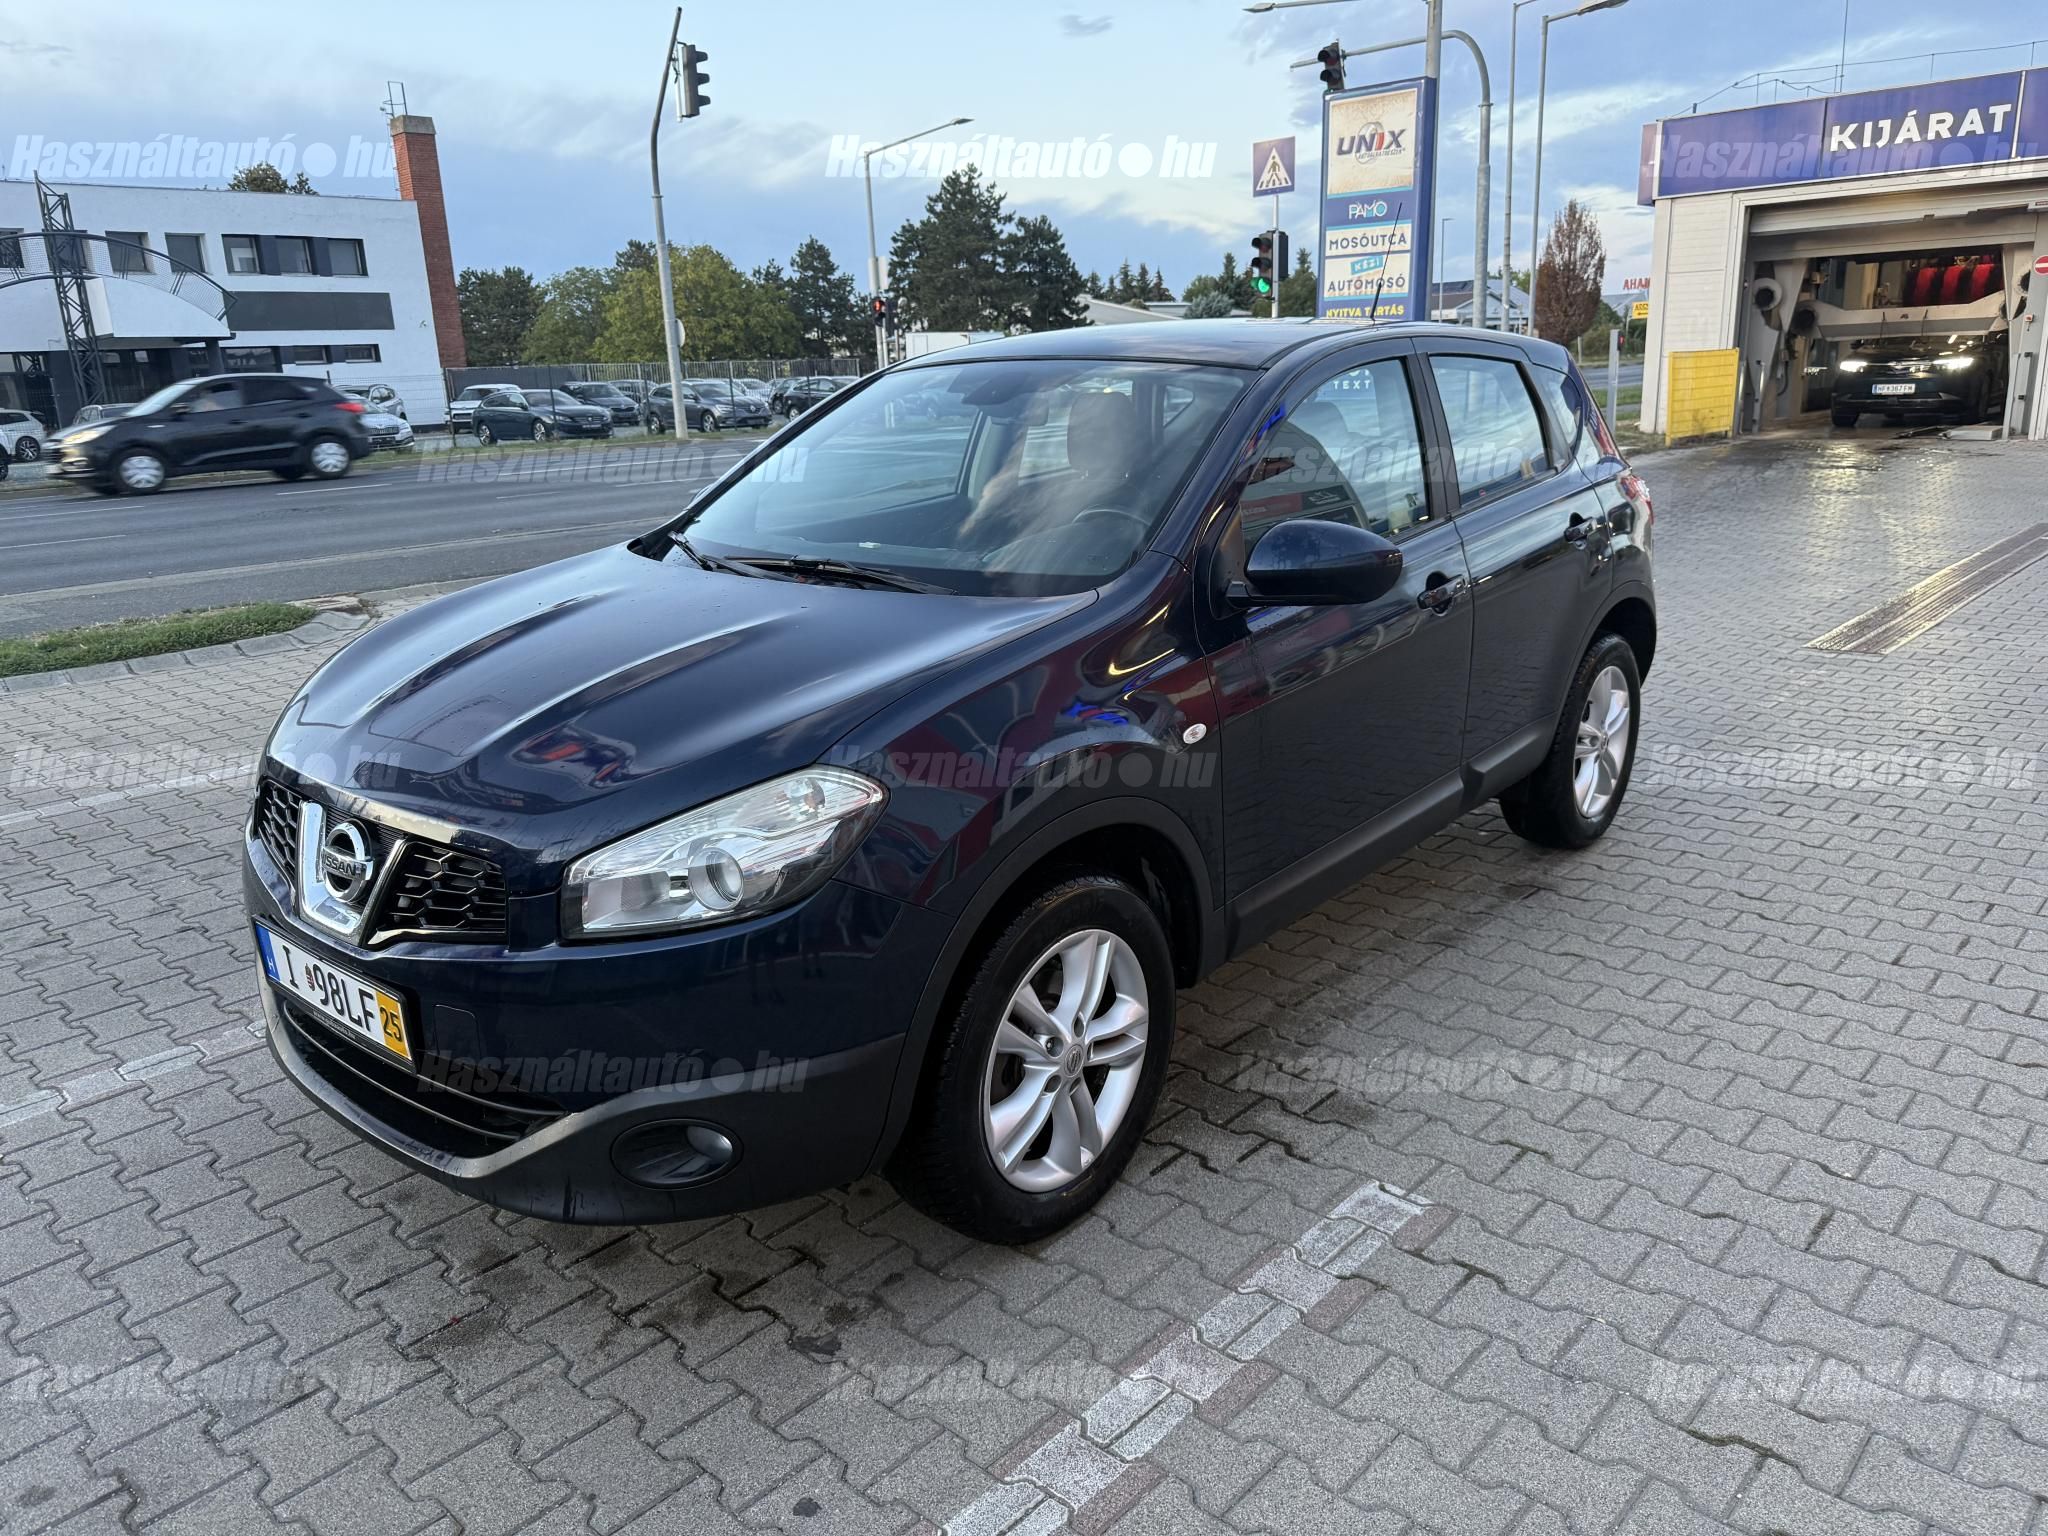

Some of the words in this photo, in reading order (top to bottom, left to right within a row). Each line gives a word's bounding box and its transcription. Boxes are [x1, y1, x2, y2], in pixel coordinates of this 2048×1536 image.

[1830, 104, 2012, 151] KIJÁRAT
[1337, 128, 1406, 156] UNIX
[1329, 232, 1407, 251] MOSÓUTCA
[1327, 307, 1362, 318] NYITVA
[1364, 303, 1404, 317] TRTÁS
[1333, 379, 1370, 390] TEXT
[266, 956, 277, 974] H
[312, 963, 376, 1033] 98LF
[380, 1006, 403, 1043] 25
